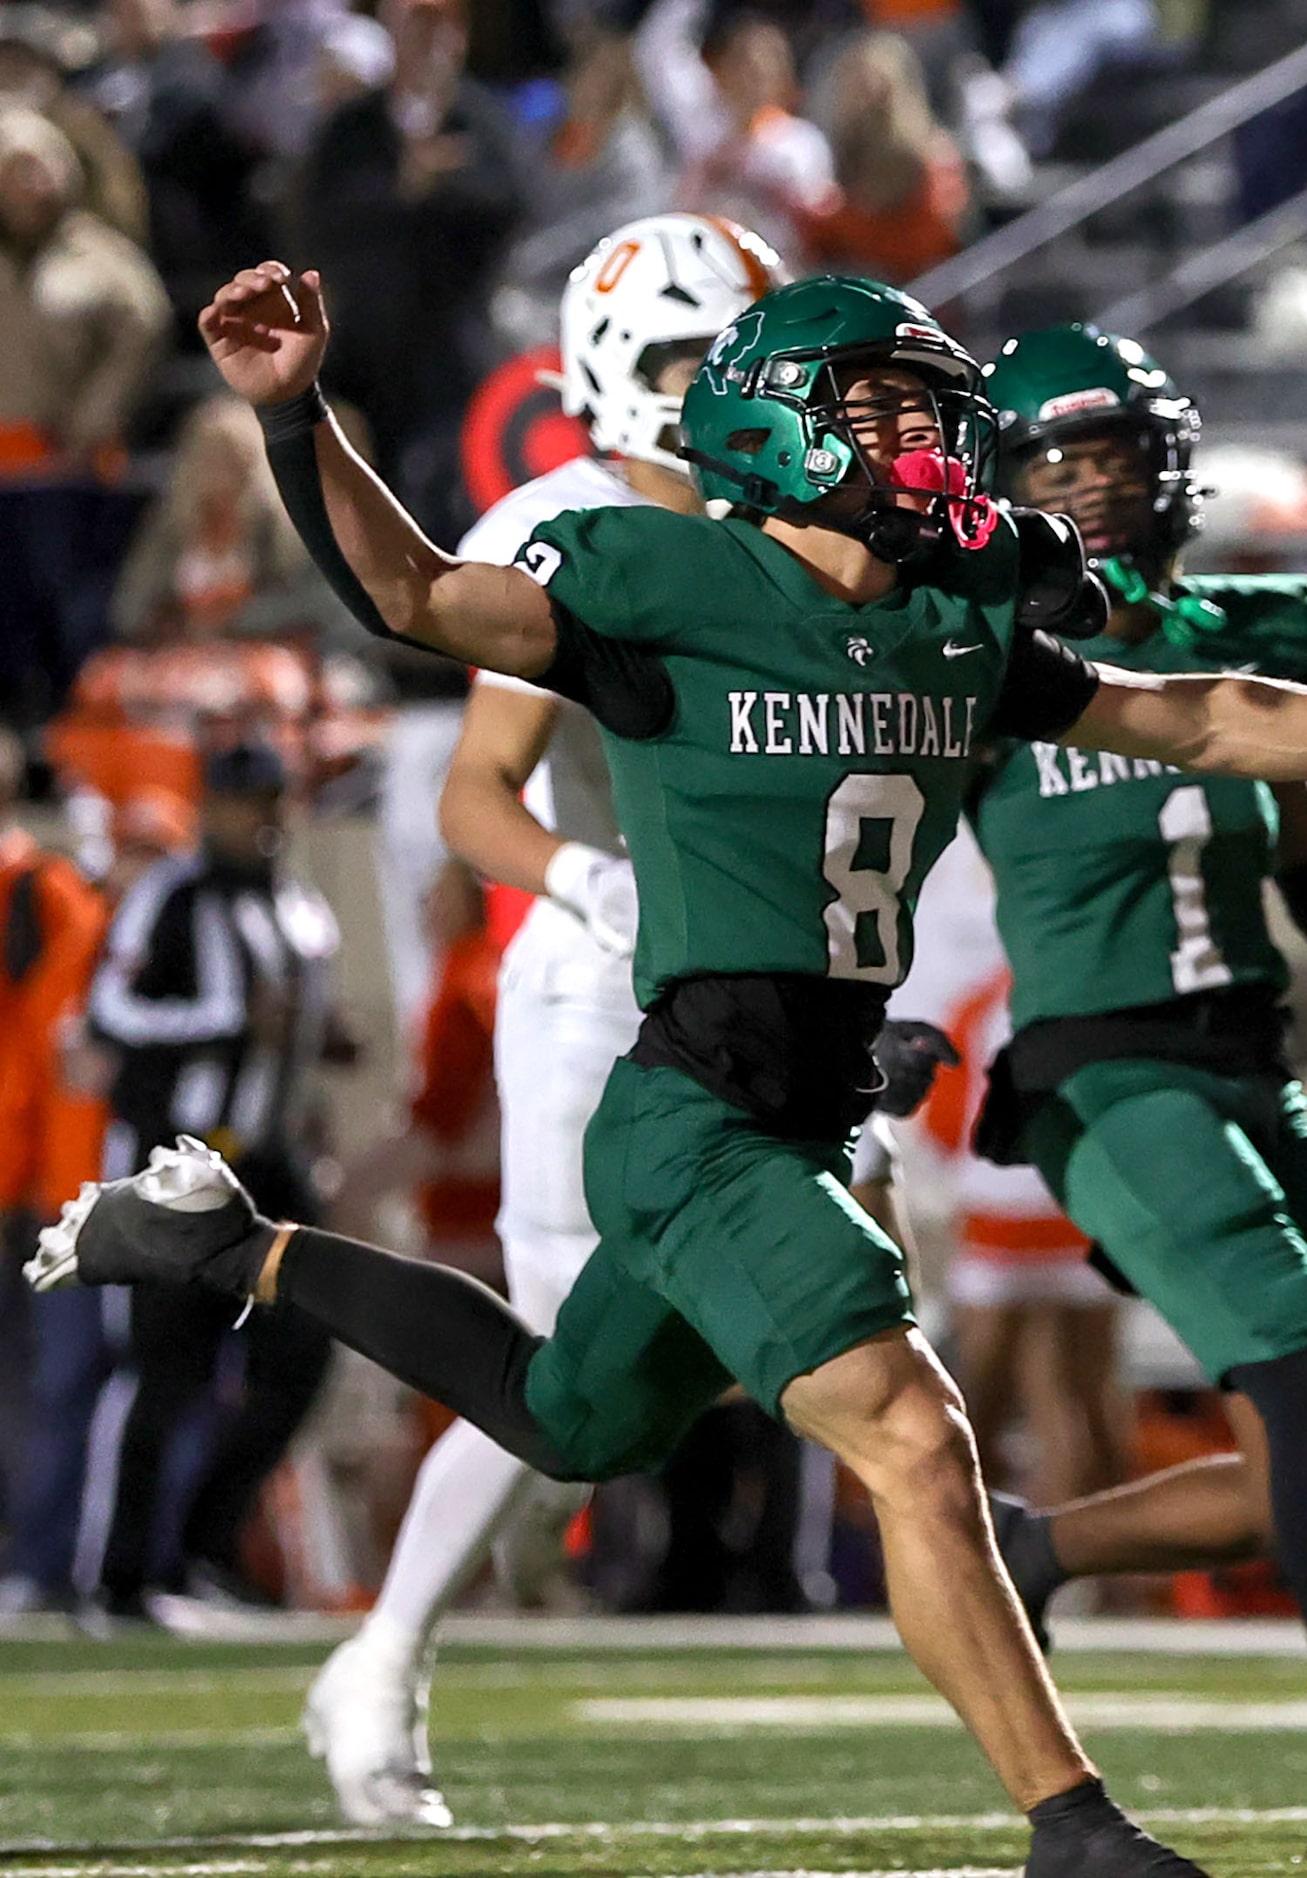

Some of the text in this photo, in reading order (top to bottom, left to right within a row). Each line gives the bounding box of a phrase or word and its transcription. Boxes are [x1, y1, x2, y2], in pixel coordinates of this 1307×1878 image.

[596, 242, 640, 293] 0
[823, 774, 925, 985] 8
[1158, 785, 1234, 993] 1
